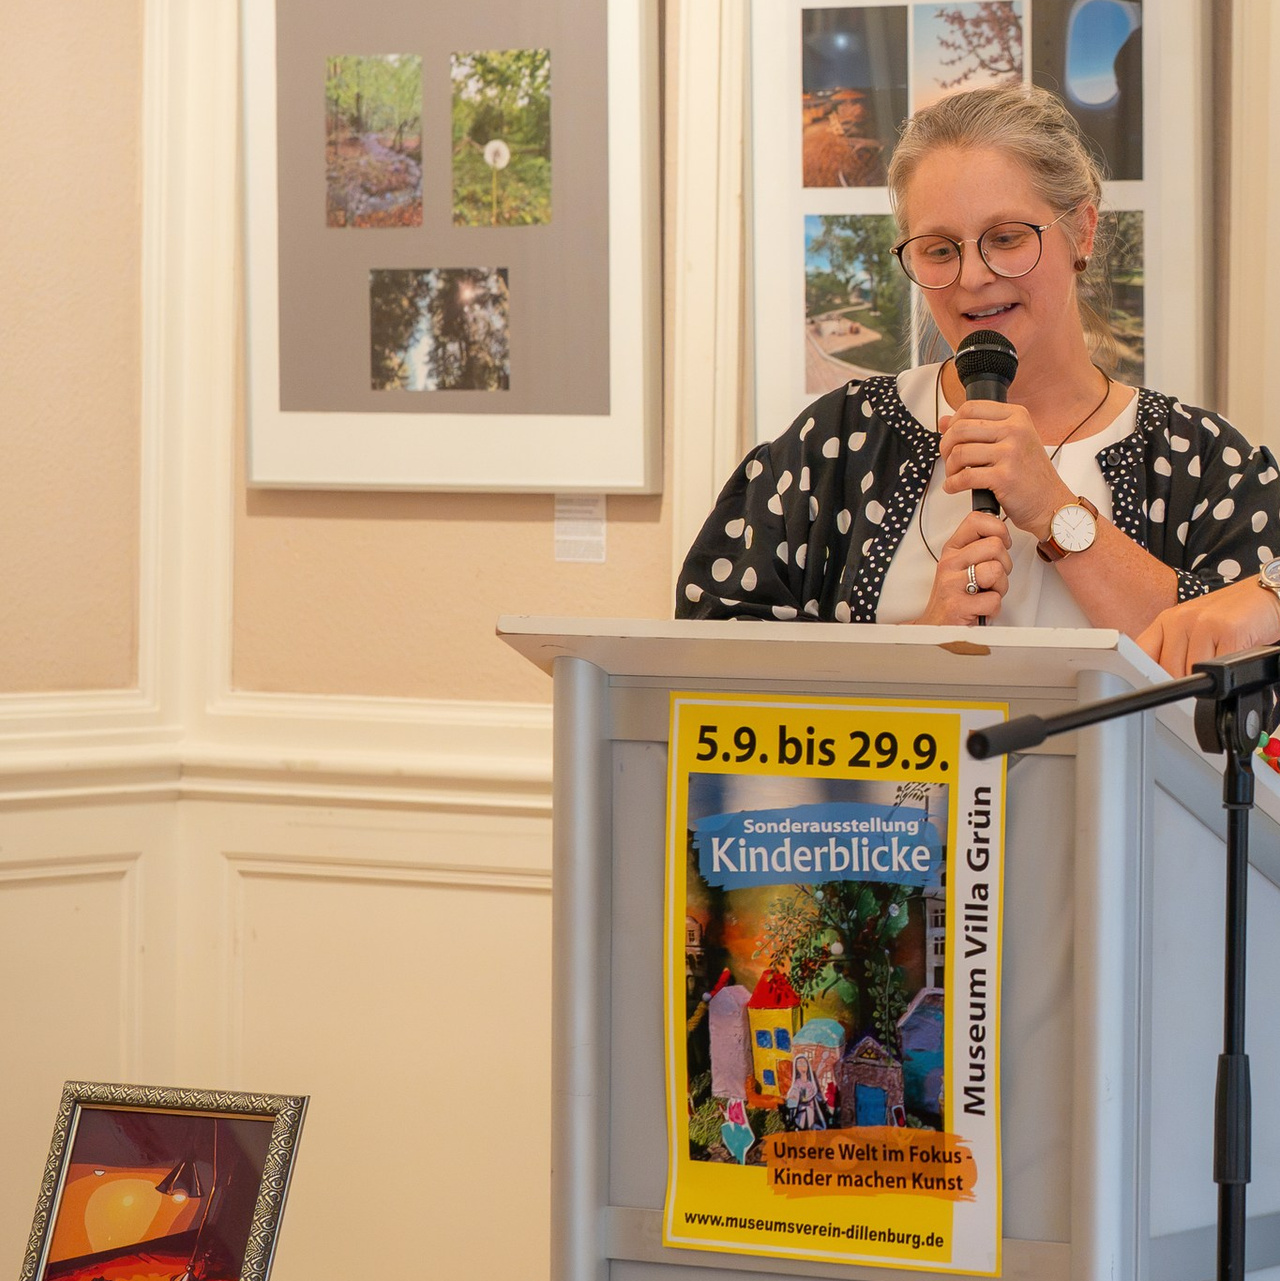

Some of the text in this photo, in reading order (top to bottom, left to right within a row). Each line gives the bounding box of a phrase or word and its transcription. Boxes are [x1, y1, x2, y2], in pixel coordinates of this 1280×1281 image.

[696, 725, 949, 772] 5.9. bis 29.9.
[743, 819, 919, 836] Sonderausstellung
[711, 836, 930, 873] Kinderblicke
[964, 786, 992, 1117] Museum Villa Grün
[774, 1142, 835, 1160] Unsere
[838, 1143, 878, 1162] Welt
[882, 1146, 905, 1162] im
[909, 1146, 962, 1164] Fokus
[774, 1168, 963, 1190] Kinder machen Kunst
[684, 1211, 944, 1249] www.museumsverein-dillenburg.de
